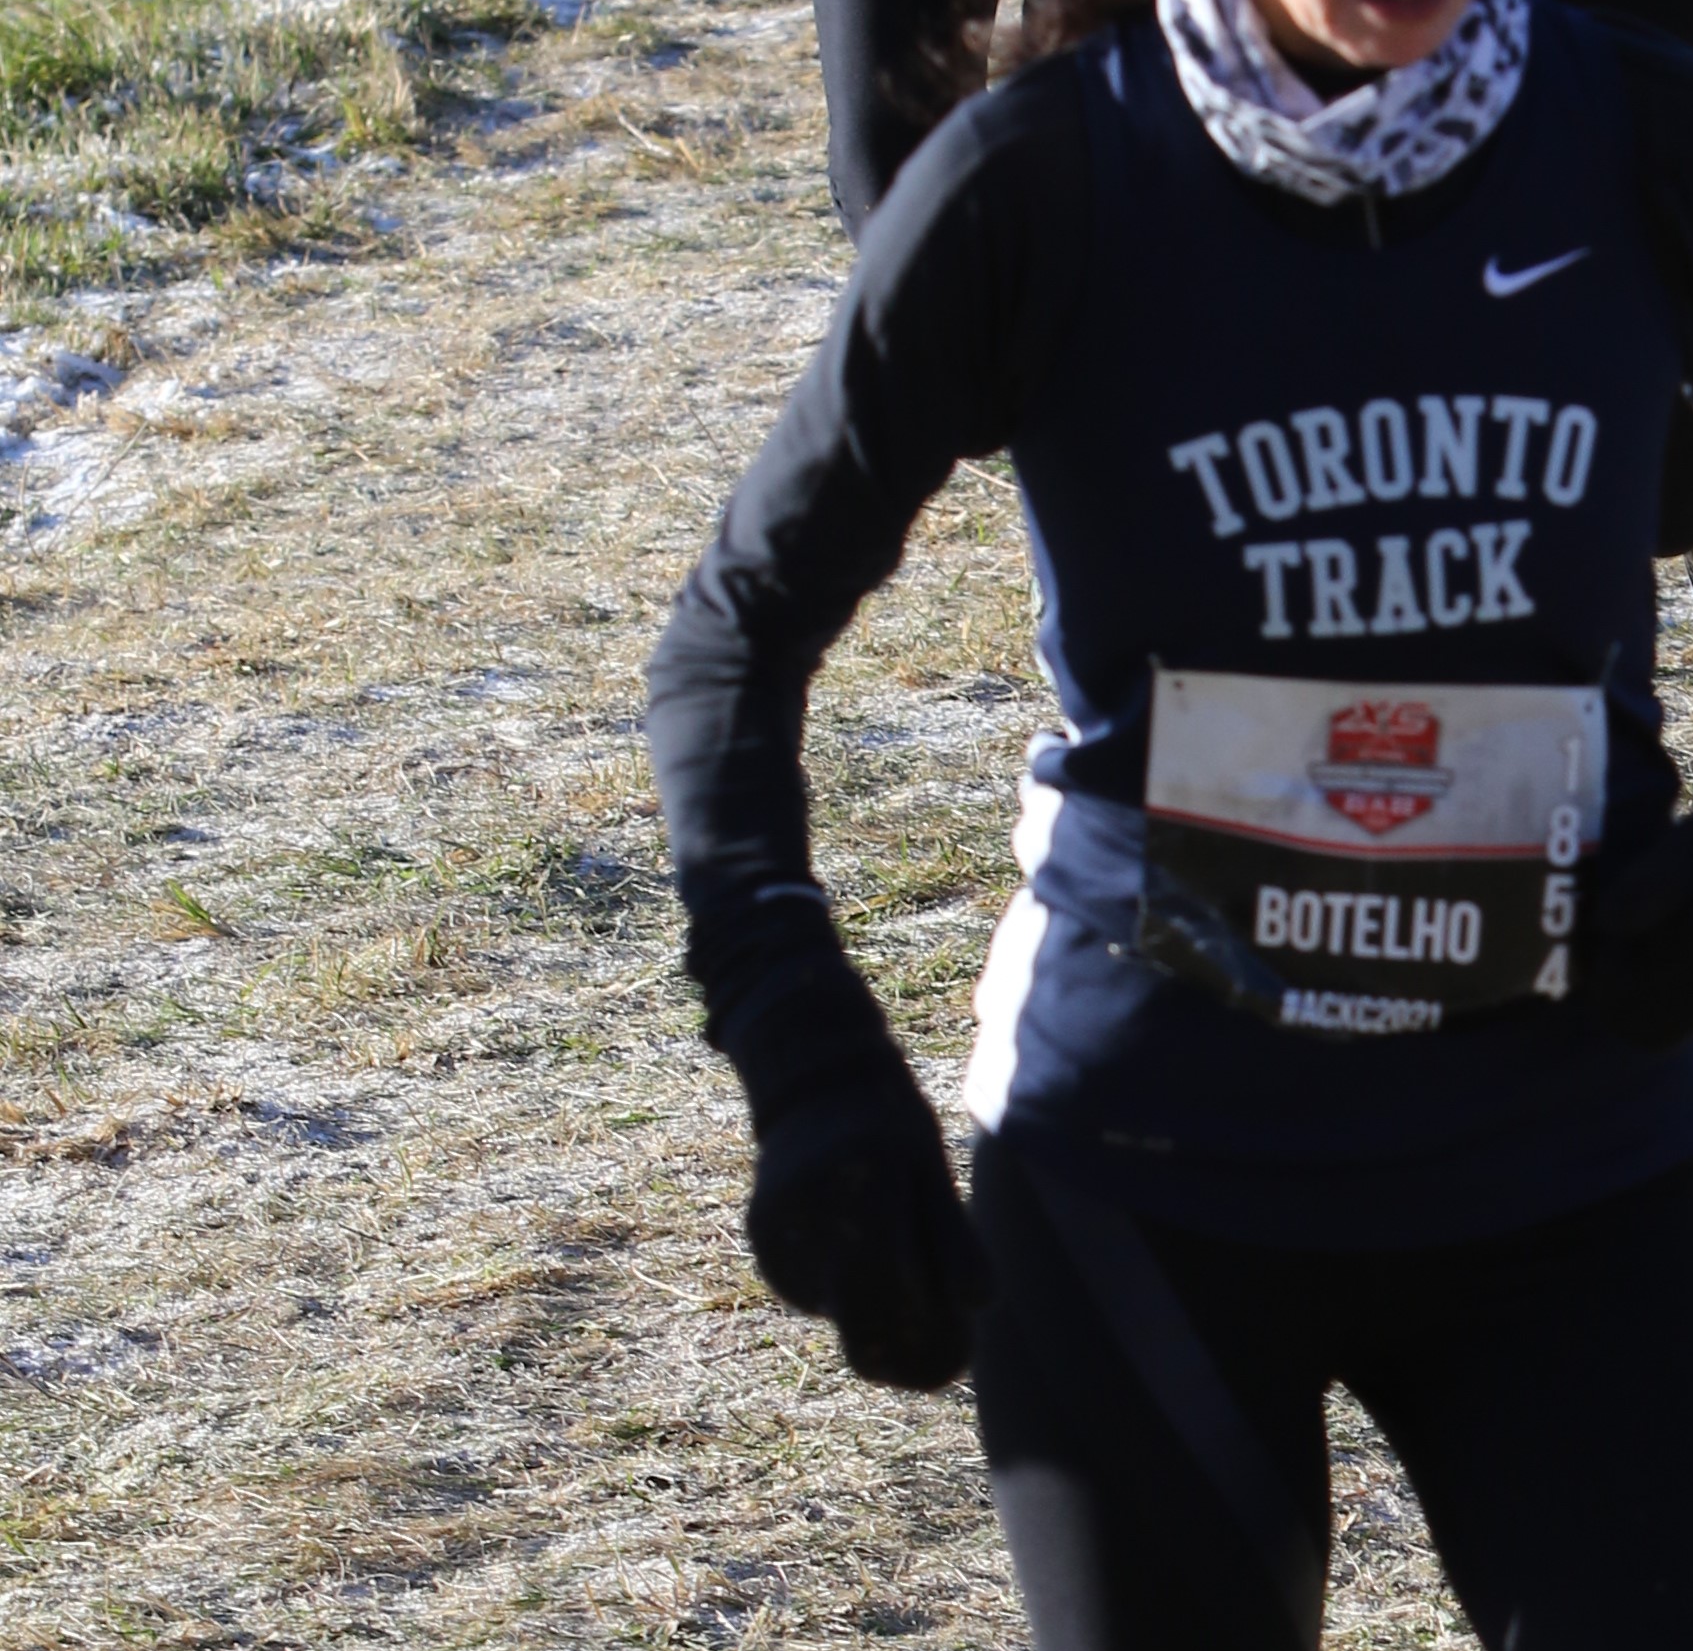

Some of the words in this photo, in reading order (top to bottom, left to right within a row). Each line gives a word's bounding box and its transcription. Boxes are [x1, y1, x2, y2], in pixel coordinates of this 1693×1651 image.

[1169, 394, 1598, 539] TORONTO
[1243, 520, 1536, 640] TRACK
[1254, 884, 1483, 966] BOTELHO
[1533, 735, 1582, 1001] 1854
